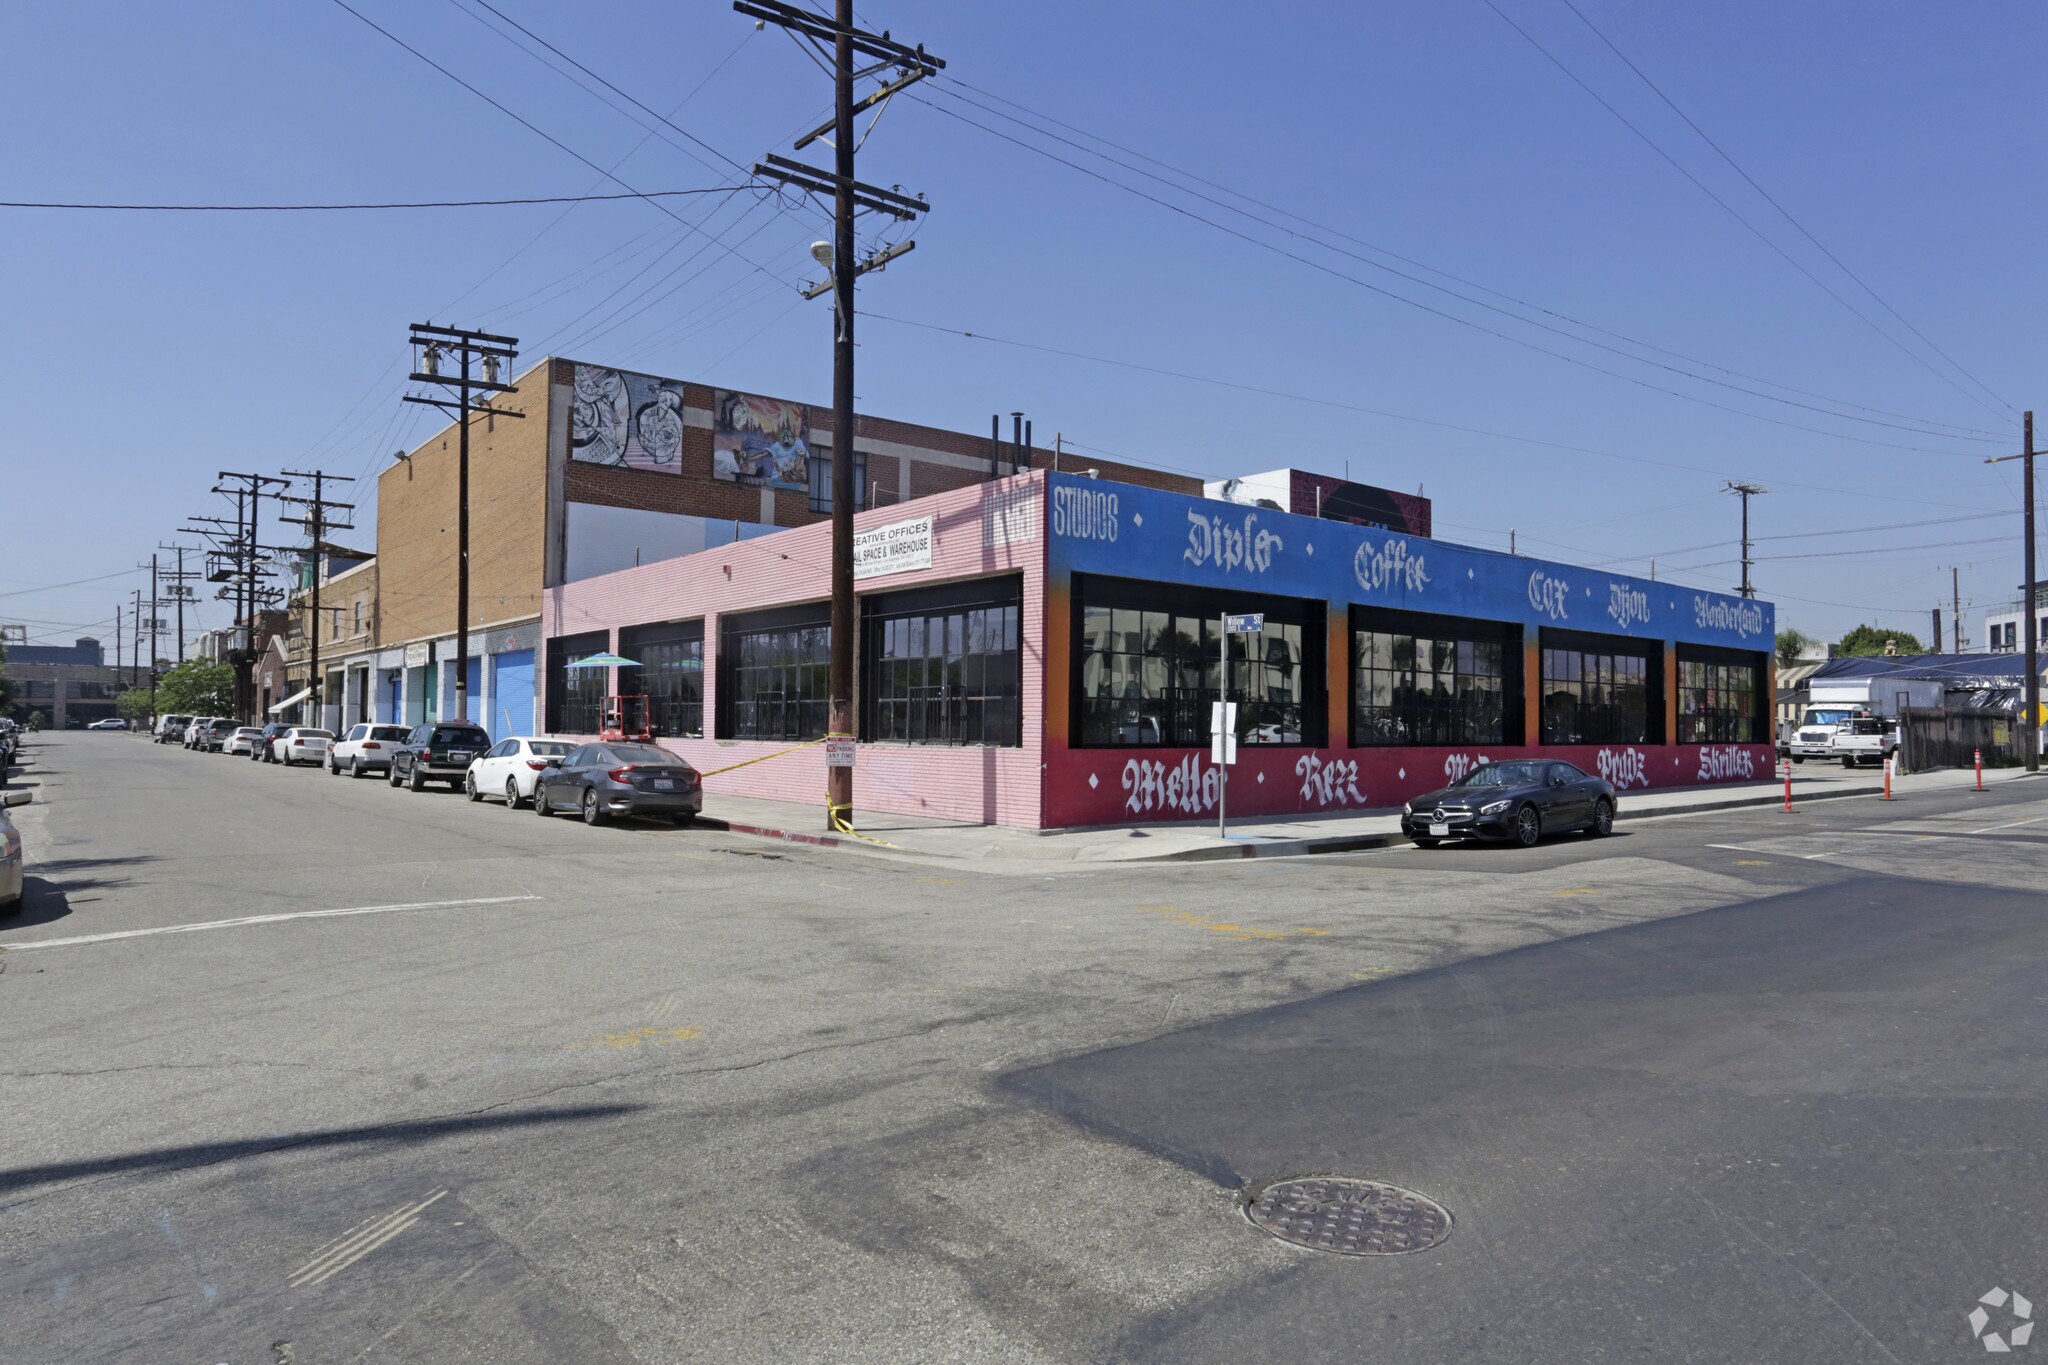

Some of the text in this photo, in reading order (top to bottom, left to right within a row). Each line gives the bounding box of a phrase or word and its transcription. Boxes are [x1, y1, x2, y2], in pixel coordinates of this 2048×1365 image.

[888, 522, 928, 539] OFFICES
[863, 547, 882, 561] SPACE
[883, 546, 887, 558] &
[890, 538, 928, 556] WAREHOUSE
[1183, 507, 1283, 574] Diplo
[1528, 569, 1569, 620] Cox
[1253, 615, 1261, 624] St
